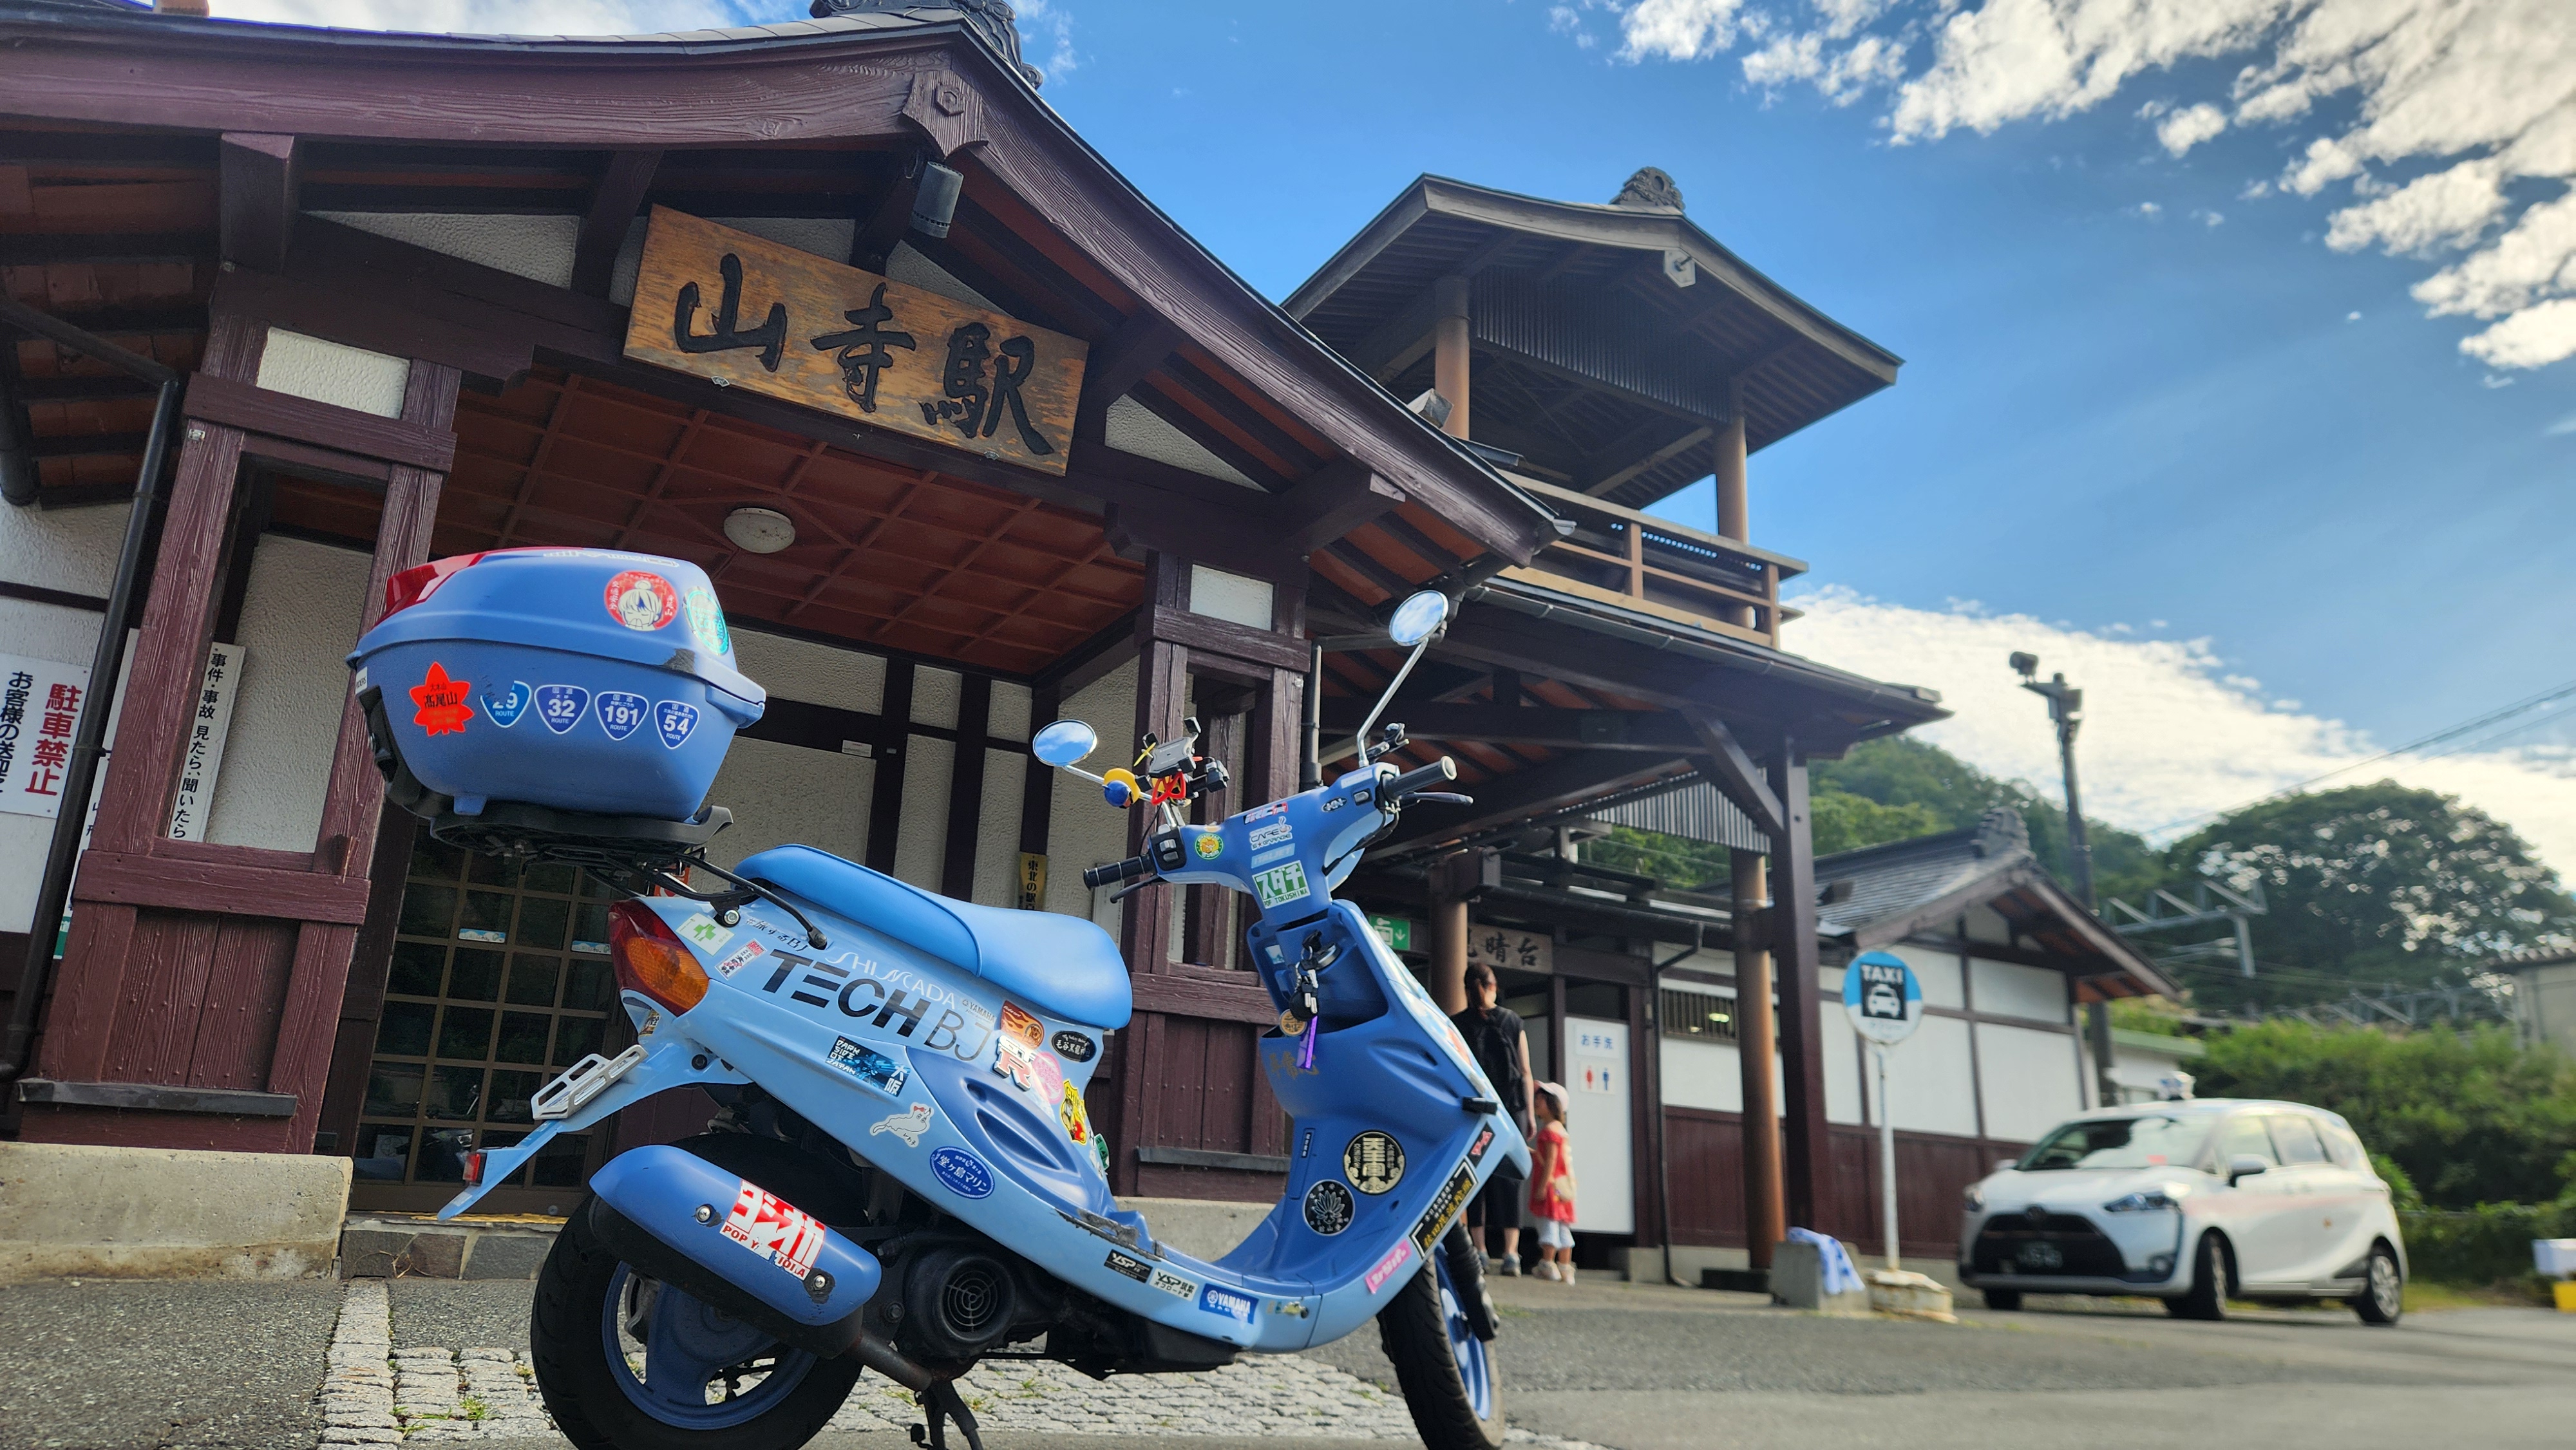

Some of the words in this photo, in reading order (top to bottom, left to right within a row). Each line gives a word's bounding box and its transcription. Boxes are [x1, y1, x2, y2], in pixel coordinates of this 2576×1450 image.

[674, 252, 1055, 456] 山寺駅
[198, 653, 227, 720] 事件・事故
[547, 699, 575, 718] 32
[605, 705, 638, 726] 191
[663, 715, 688, 735] 54
[24, 683, 82, 796] 駐車禁止
[666, 732, 681, 740] ROUTE
[1251, 828, 1280, 843] CAFE
[1255, 846, 1292, 865] ITALJET
[1256, 864, 1302, 900] スダチ
[1275, 889, 1308, 904] TOKUSHIMA
[1861, 965, 1904, 985] TAXI
[762, 948, 932, 1038] TECH
[923, 1008, 993, 1061] BJ
[970, 1002, 996, 1021] YAMAHA
[836, 1039, 860, 1055] DARK
[1581, 1033, 1613, 1050] お手洗
[829, 1051, 844, 1061] OF
[834, 1046, 855, 1060] SIDE
[826, 1059, 857, 1075] JAPAN
[884, 1065, 908, 1095] 大阪
[1362, 1137, 1386, 1176] 天王宮
[936, 1154, 988, 1192] 堂ヶ島マリン
[722, 1225, 748, 1242] POP
[1112, 1253, 1137, 1268] YSP
[1157, 1272, 1182, 1287] YSP
[1218, 1293, 1251, 1314] YAMAHA
